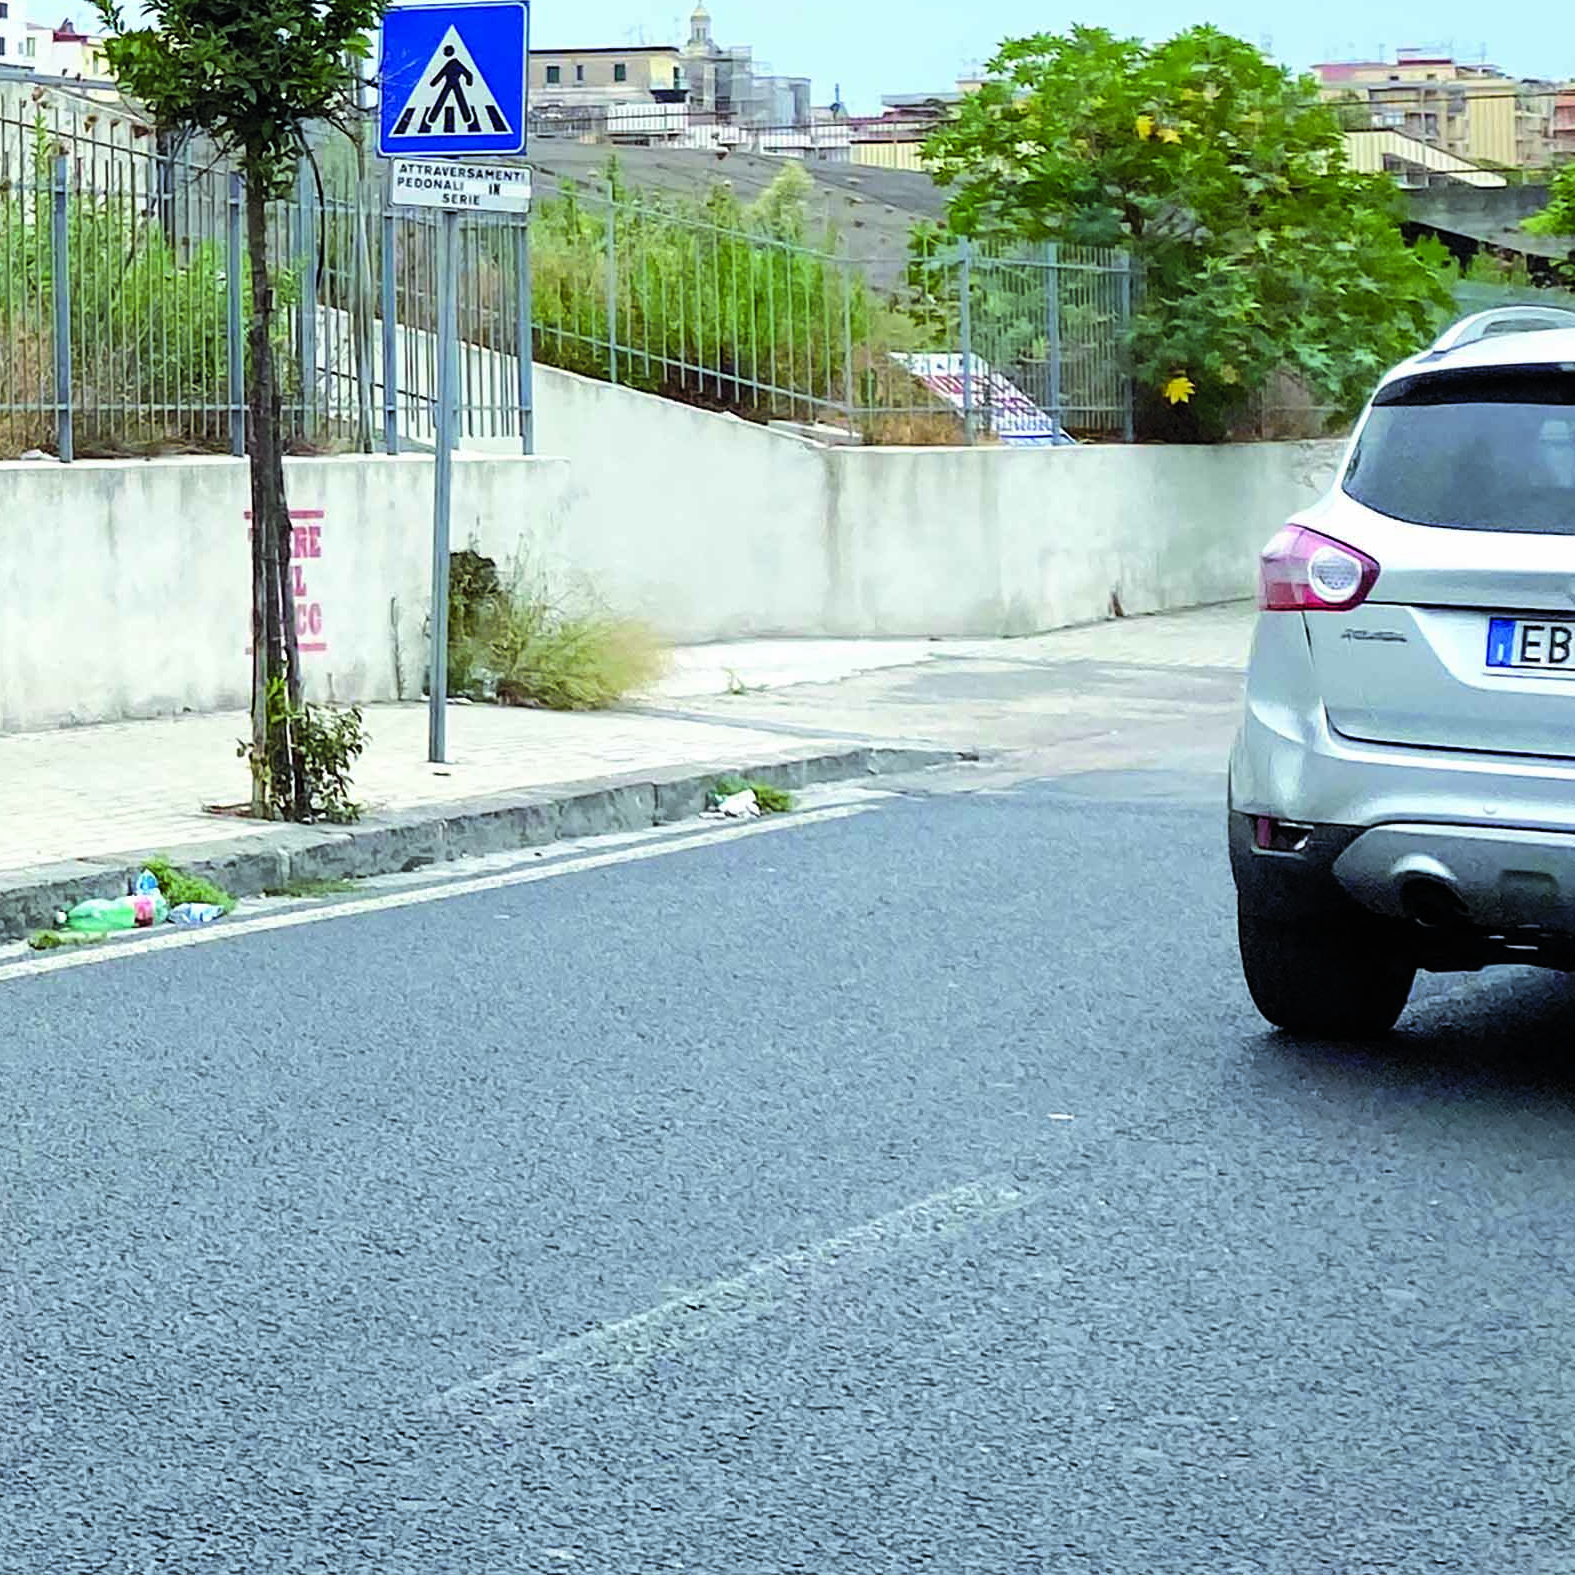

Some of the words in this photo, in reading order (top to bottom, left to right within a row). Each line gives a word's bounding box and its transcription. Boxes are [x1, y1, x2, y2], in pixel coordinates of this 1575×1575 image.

[399, 164, 525, 181] ATTRAVERSAMENTI
[397, 176, 464, 191] PEDONALI
[442, 193, 481, 205] SERIE
[1520, 625, 1573, 663] EB
